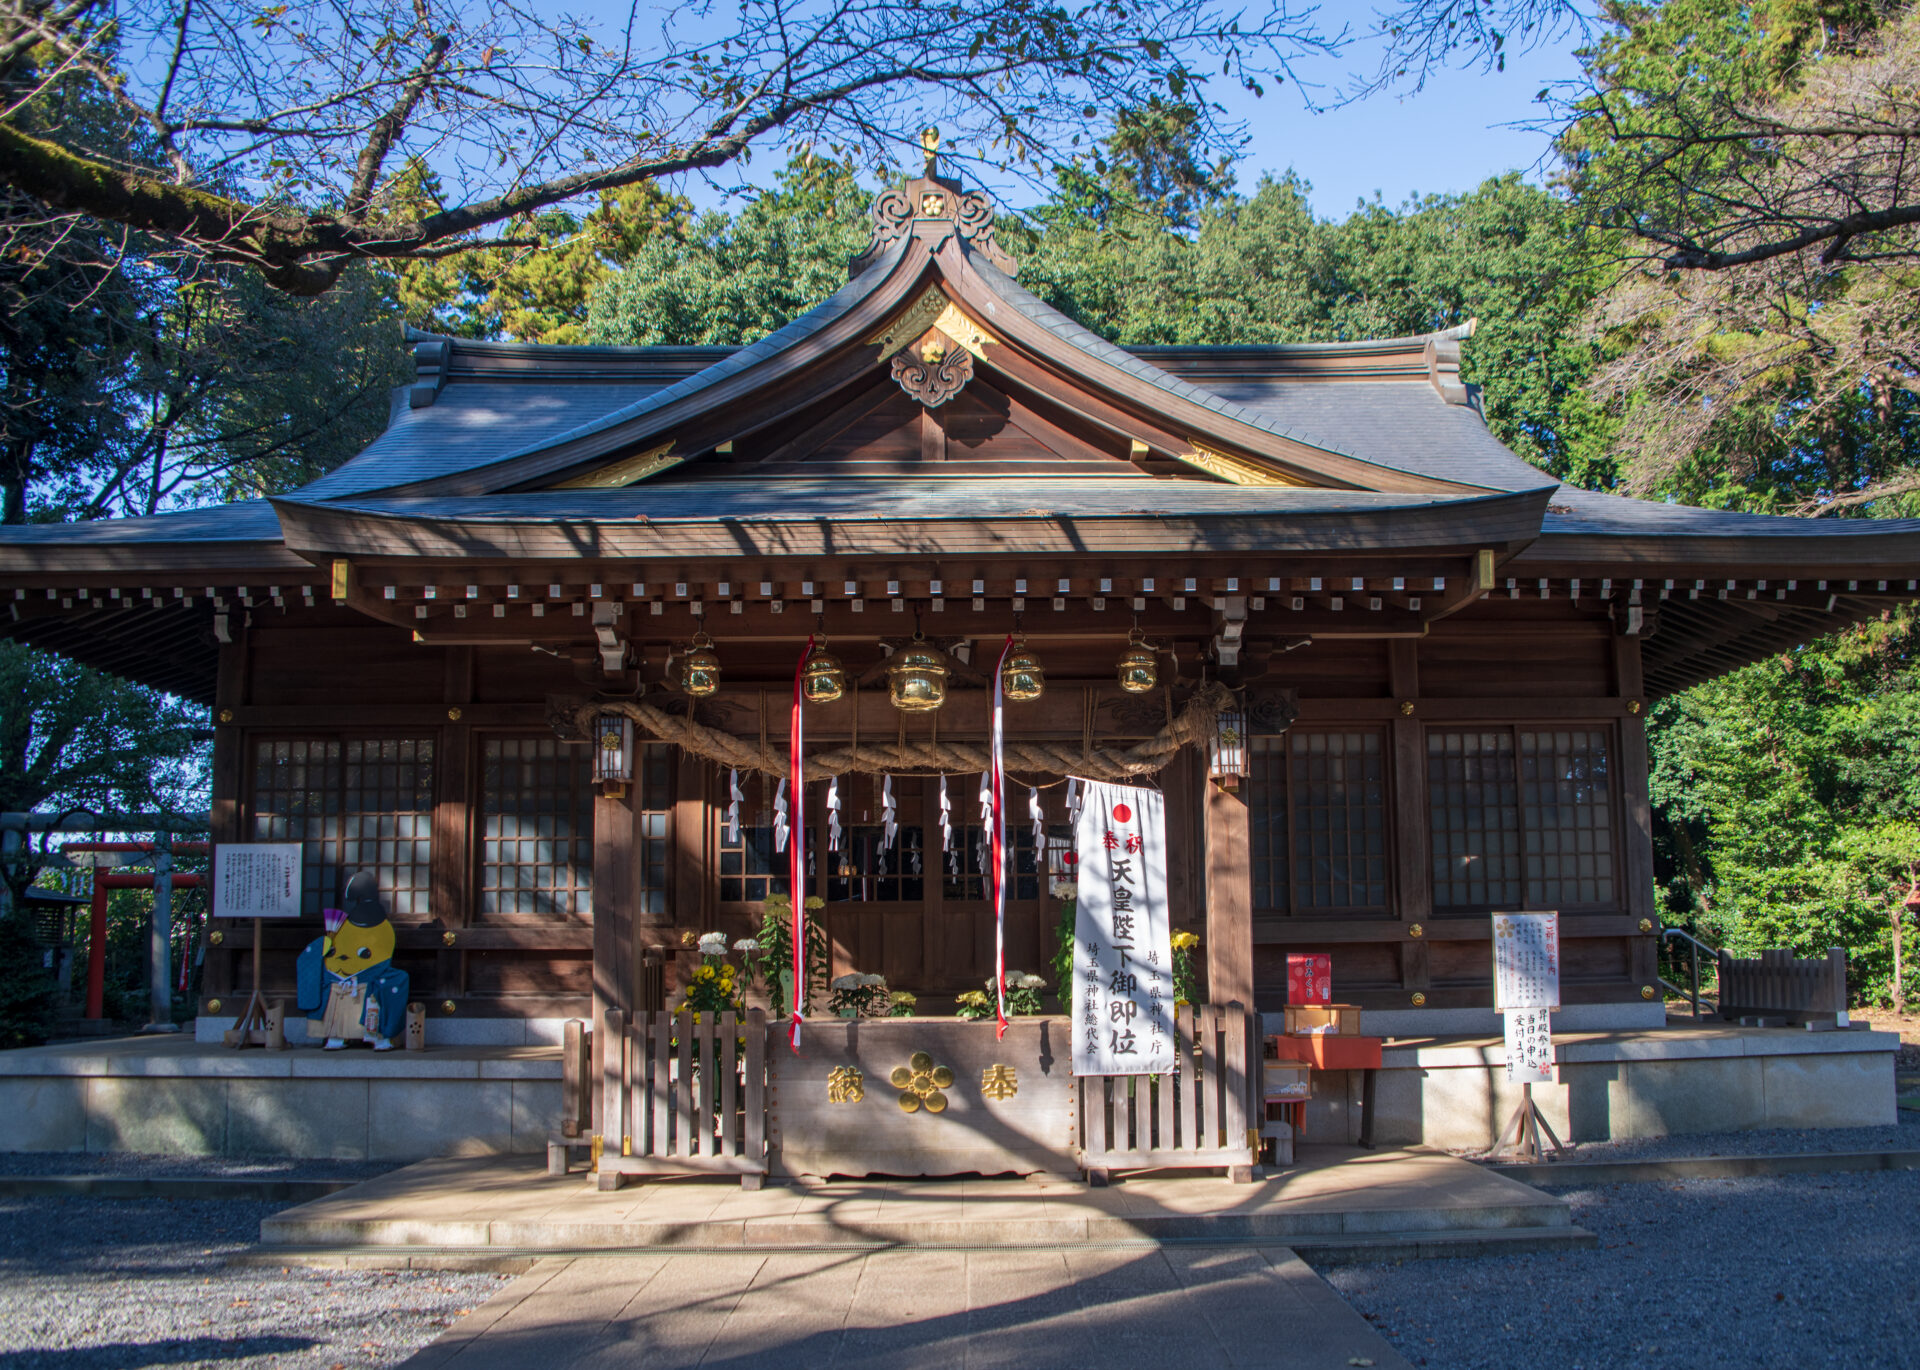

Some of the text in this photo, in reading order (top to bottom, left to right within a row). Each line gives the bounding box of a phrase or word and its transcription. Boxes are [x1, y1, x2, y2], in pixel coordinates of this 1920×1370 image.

[1102, 830, 1145, 857] 奉祝
[1108, 858, 1138, 1055] 天皇陛下御即位
[1305, 957, 1314, 999] おみくじ
[1084, 941, 1100, 1055] 埼玉県神社総代会
[1147, 949, 1164, 1055] 埼玉県神社庁
[1514, 1014, 1526, 1064] 受付ます
[1527, 1014, 1538, 1069] 当日の申込
[1538, 1008, 1549, 1059] 昇殿参拝
[828, 1063, 1018, 1104] 奉 納
